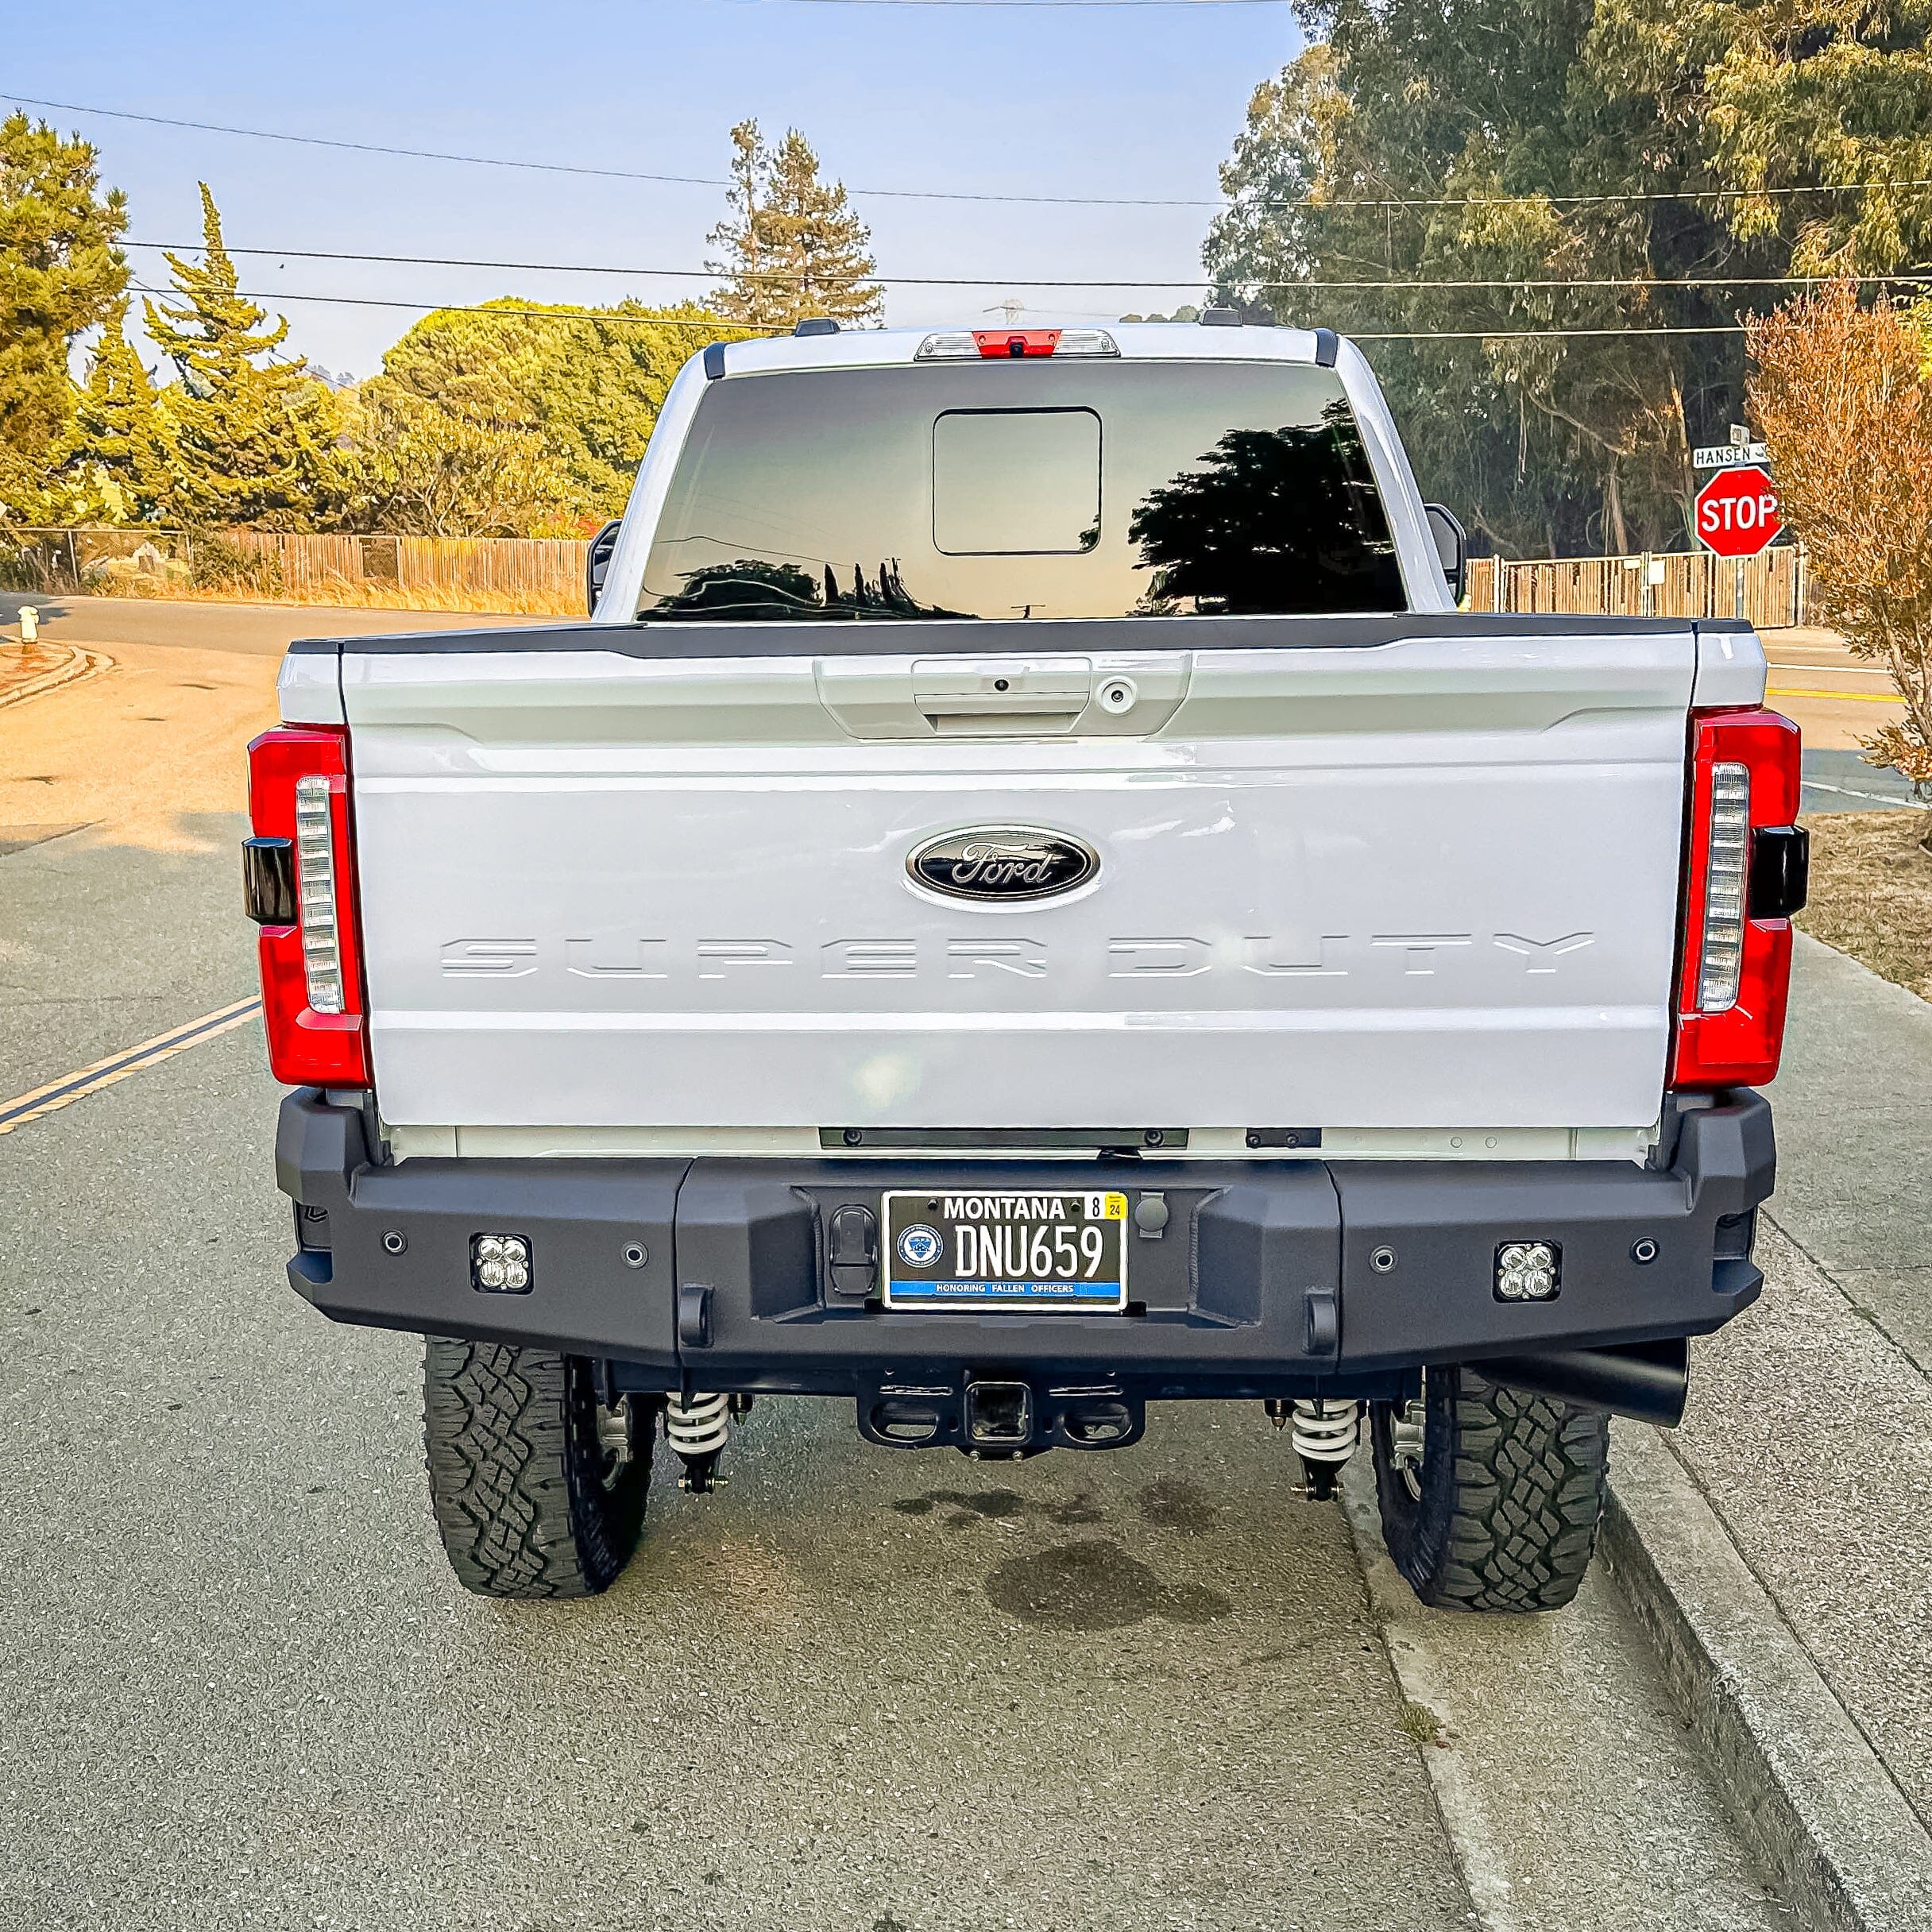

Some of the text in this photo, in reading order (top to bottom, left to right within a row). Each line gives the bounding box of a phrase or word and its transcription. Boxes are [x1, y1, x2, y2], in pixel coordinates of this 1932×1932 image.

[1696, 447, 1751, 465] HANSEN
[1701, 494, 1779, 532] STOP
[952, 842, 1053, 883] Ford
[441, 931, 1595, 979] SUPER DUTY
[944, 1197, 1065, 1219] MONTANA
[1092, 1196, 1099, 1217] 8
[1109, 1204, 1120, 1215] 24
[955, 1225, 1103, 1277] DNU659
[936, 1284, 1073, 1293] HONORING FALLEN OFFICERS
